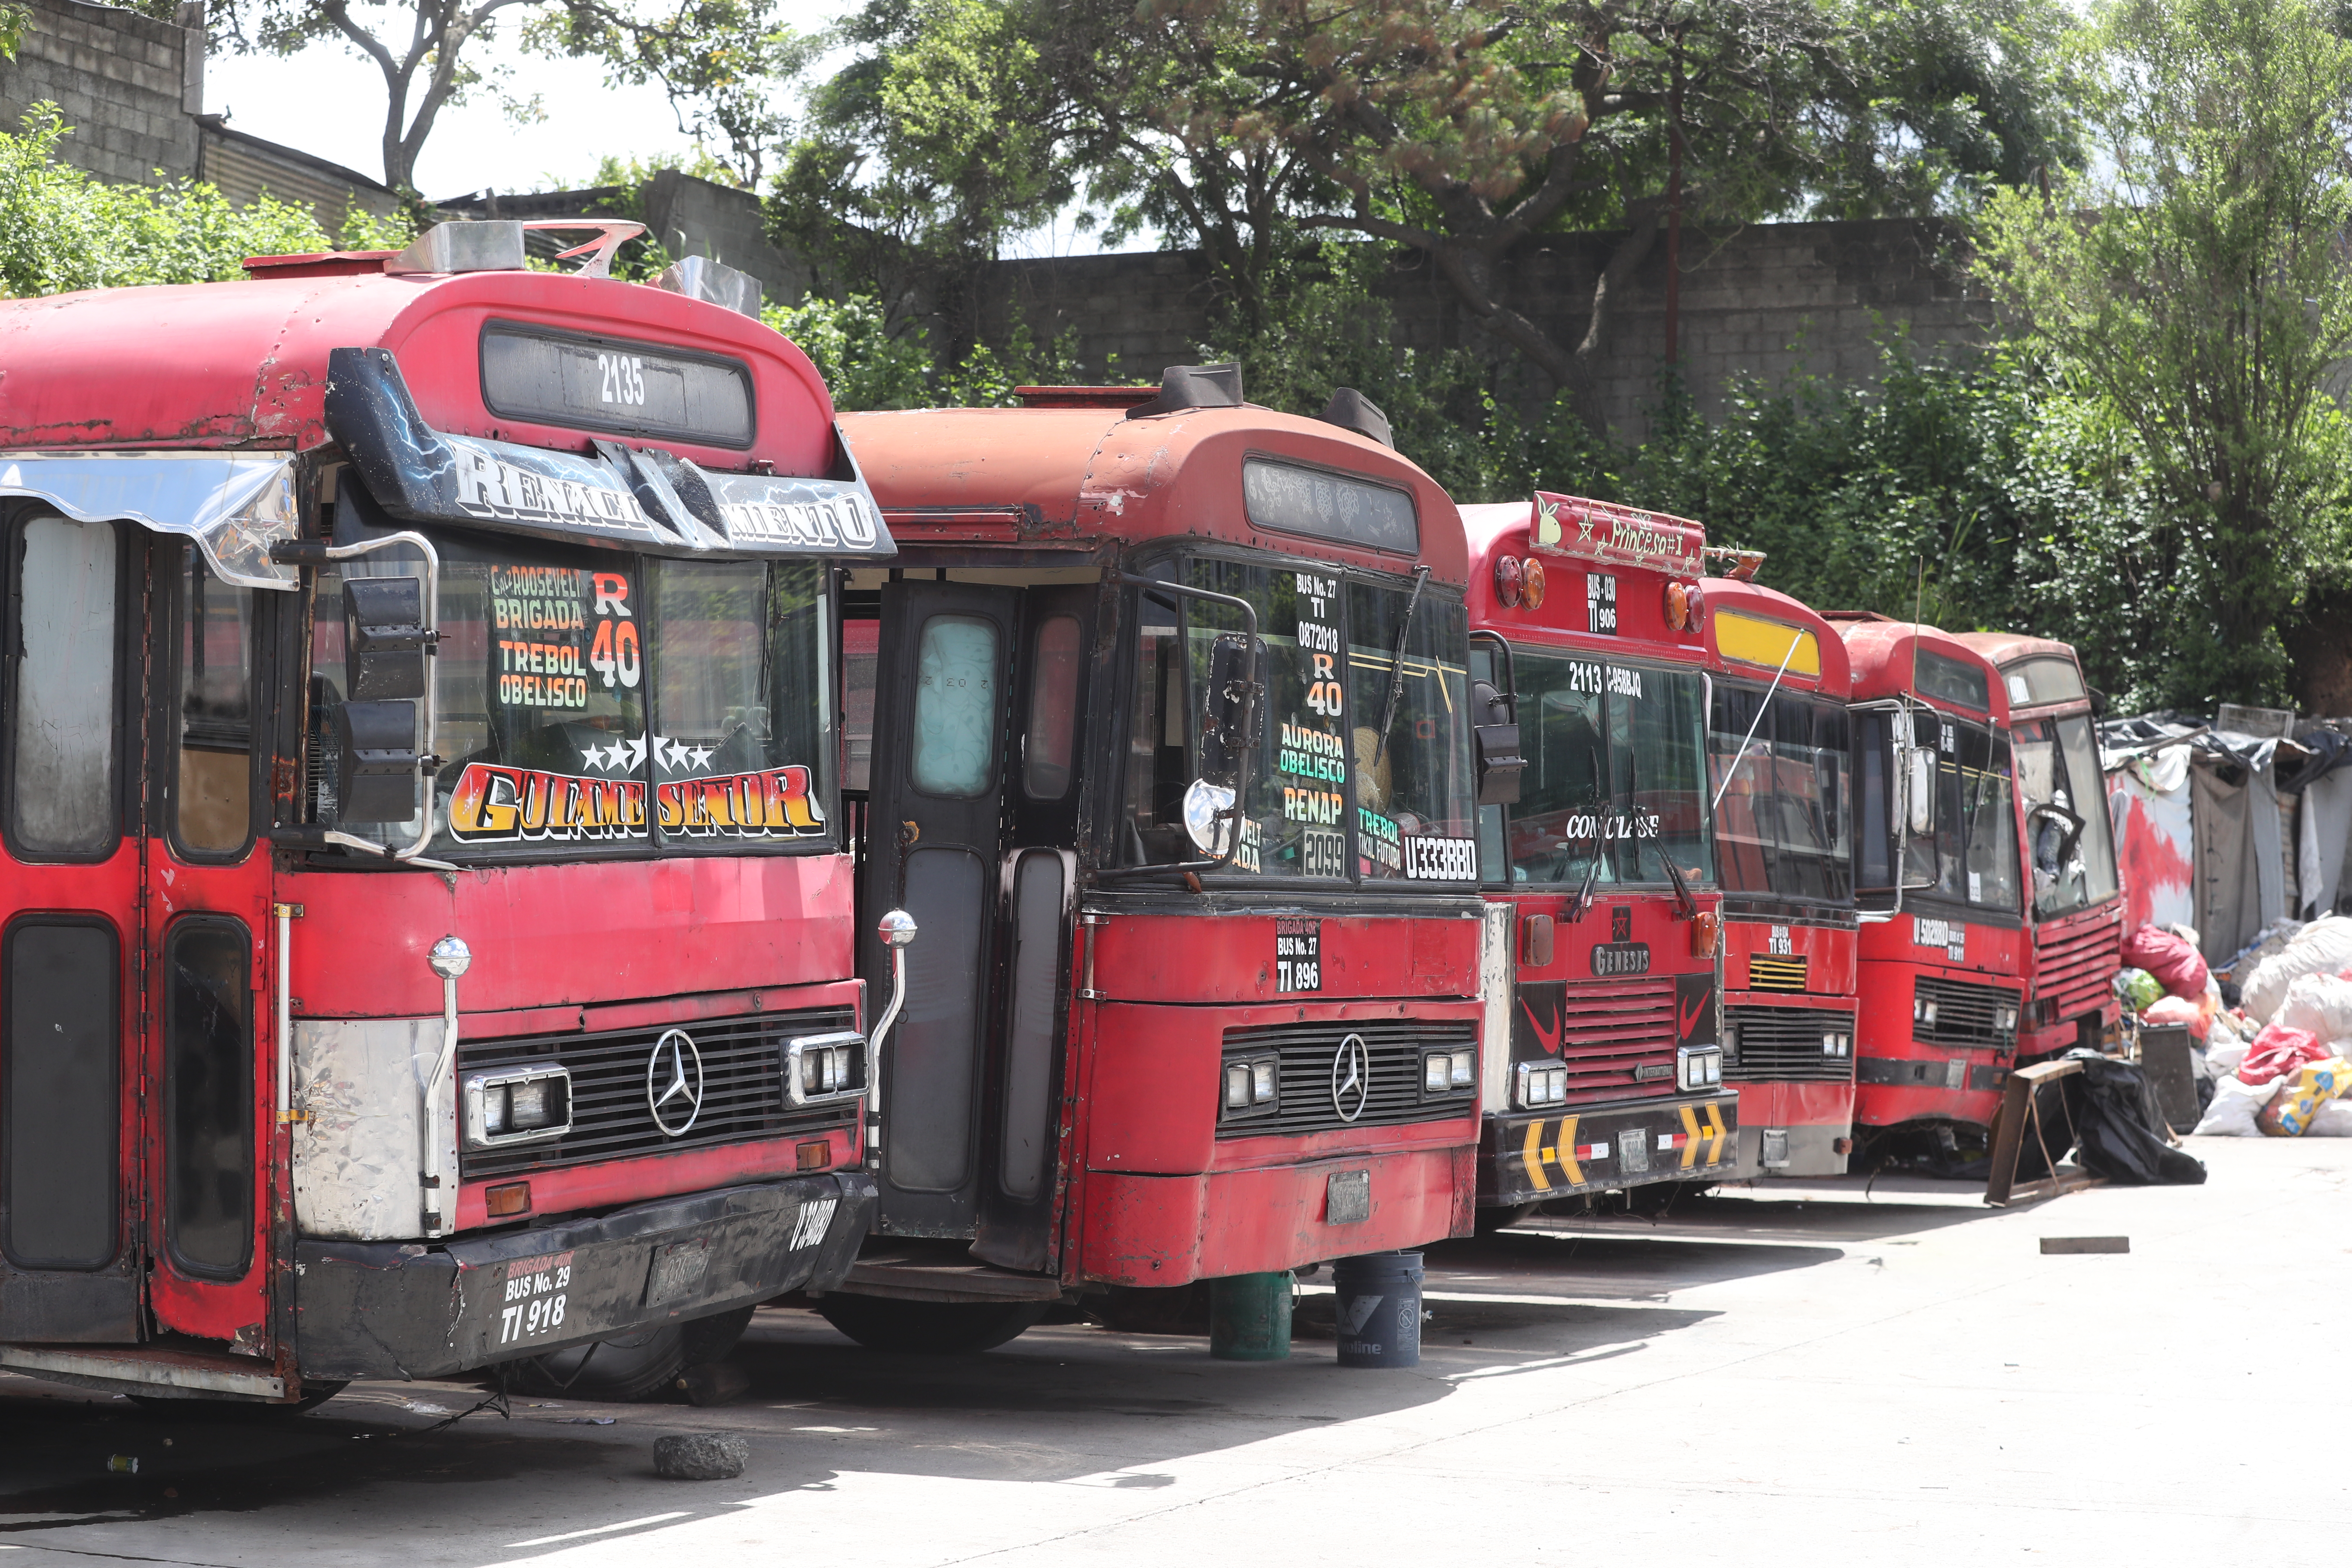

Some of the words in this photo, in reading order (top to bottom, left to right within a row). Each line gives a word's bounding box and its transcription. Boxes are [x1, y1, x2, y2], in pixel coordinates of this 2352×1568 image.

[599, 354, 644, 405] 2135
[446, 438, 654, 530] RENACI
[720, 491, 876, 549] MIENTO
[592, 573, 632, 616] R
[1297, 573, 1312, 596] BUS
[1314, 576, 1326, 597] No.
[1327, 579, 1336, 598] 27
[1587, 574, 1600, 600] BUS
[1605, 576, 1616, 602] 030
[494, 599, 584, 630] BRIGADA
[1311, 597, 1325, 618] TI
[1588, 600, 1597, 632] TI
[1599, 608, 1616, 628] 906
[590, 620, 640, 687] 40
[1298, 621, 1338, 653] 0872018
[499, 640, 586, 676] TREBOL
[1313, 653, 1334, 680] R
[500, 674, 586, 707] OBELISCO
[1570, 662, 1602, 694] 2113
[1606, 665, 1642, 700] C-958BJQ
[1307, 681, 1342, 717] 40
[1282, 723, 1344, 759] AURORA
[1280, 749, 1345, 784] OBELISCO
[1284, 787, 1343, 824] RENAP
[1358, 807, 1400, 846] TREBOL
[1305, 833, 1344, 877] 2099
[1358, 832, 1375, 860] TIKAL
[1377, 841, 1401, 871] FUTURA
[1405, 836, 1477, 880] U333BBD
[1277, 920, 1304, 935] BRIGADA
[1305, 920, 1316, 935] 40R
[1914, 917, 1920, 943] U
[1277, 937, 1293, 955] BUS
[1295, 937, 1306, 955] No.
[1308, 937, 1317, 955] 27
[1768, 938, 1776, 954] TI
[1778, 938, 1792, 955] 931
[1277, 961, 1291, 992] TI
[1296, 962, 1318, 989] 896
[789, 1203, 807, 1252] U
[507, 1256, 554, 1279] BRIGADA
[554, 1250, 576, 1268] 40R
[505, 1276, 531, 1302] BUS
[533, 1273, 552, 1295] No.
[555, 1266, 570, 1289] 29
[501, 1305, 523, 1344] TI
[527, 1294, 567, 1332] 918
[1340, 1341, 1382, 1354] voline
